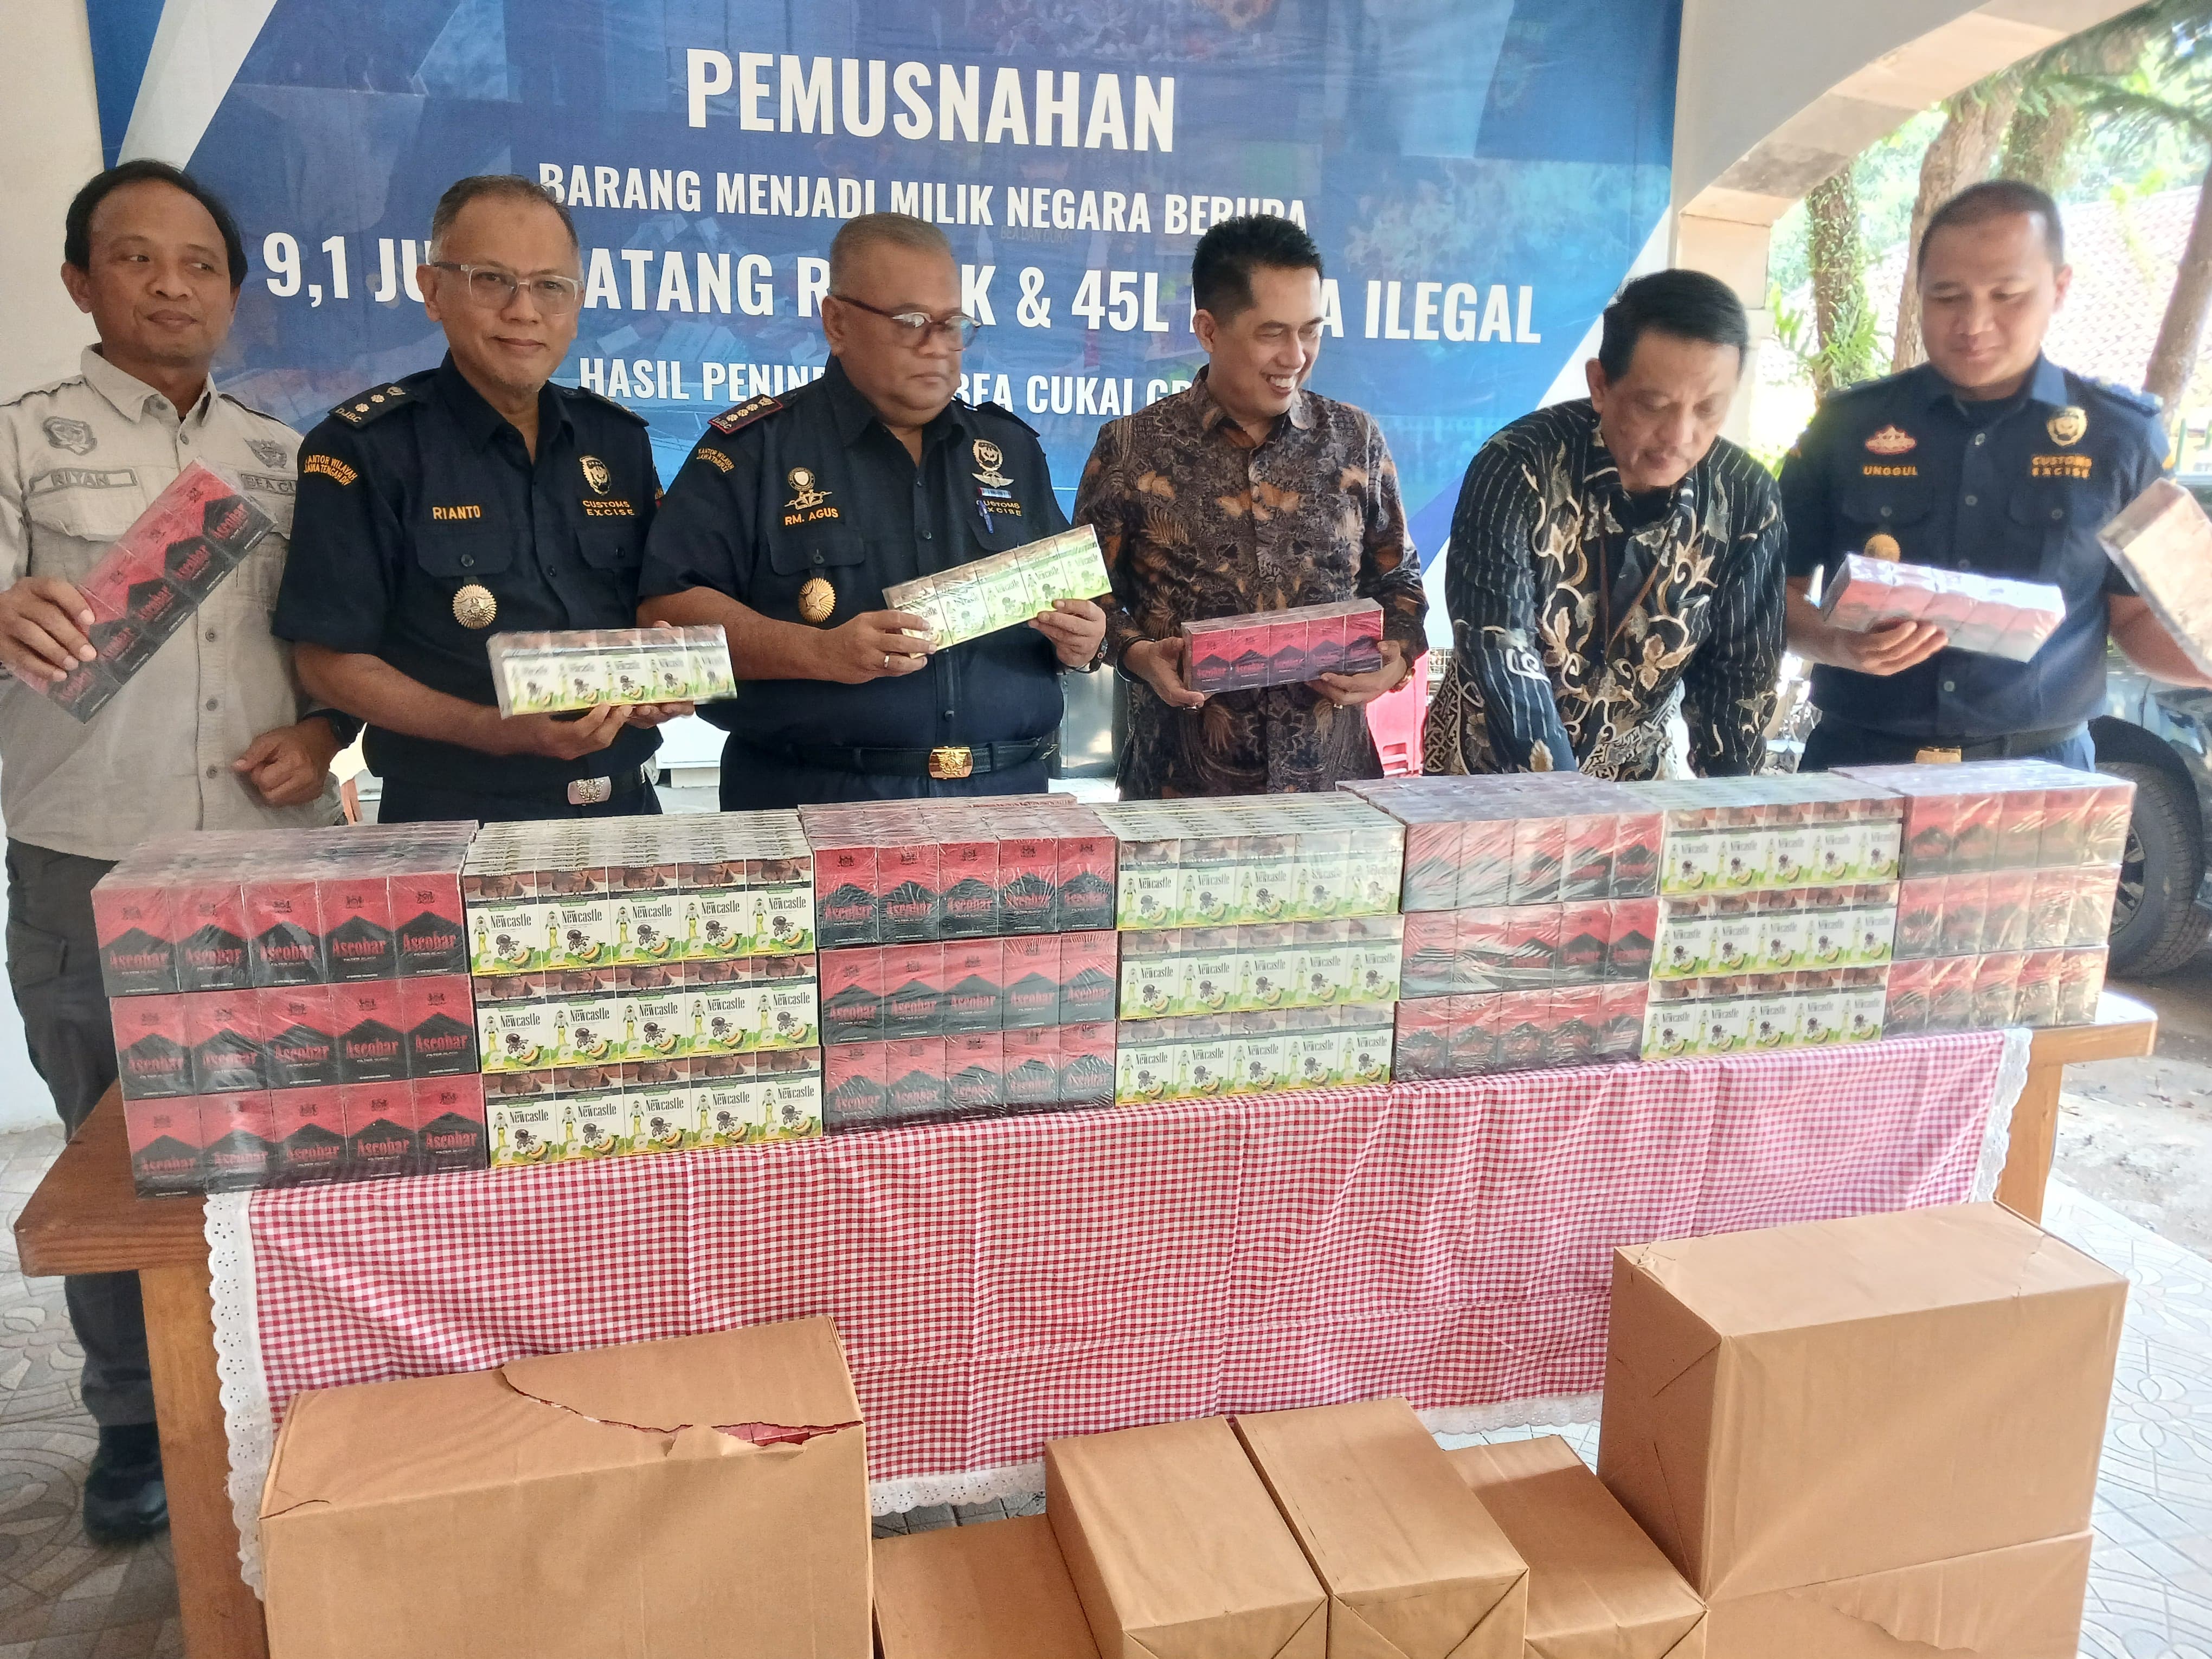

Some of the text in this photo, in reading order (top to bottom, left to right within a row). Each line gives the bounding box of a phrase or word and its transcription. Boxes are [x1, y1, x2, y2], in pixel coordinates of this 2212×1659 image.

[686, 48, 1175, 153] PEMUSNAHAN
[539, 163, 702, 213] BARANG
[716, 172, 875, 219] MENJADI
[890, 181, 994, 226] MILIK
[1007, 187, 1151, 234] NEGARA
[263, 232, 349, 308] 9,1
[583, 247, 774, 317] ATANG
[1016, 266, 1051, 328] &
[1071, 270, 1169, 332] 45L
[1365, 280, 1542, 344] ILEGAL
[580, 357, 690, 400] HASIL
[1026, 375, 1133, 416] CUKAI
[335, 408, 362, 422] DJBC
[304, 462, 320, 473] JAWA
[320, 464, 343, 480] TENGAH
[331, 458, 358, 481] WILAYAH
[51, 471, 110, 487] RIYAN
[432, 505, 481, 520] RIANTO
[785, 507, 839, 526] RM. AGUS
[987, 507, 1022, 517] XCISE
[1138, 874, 1172, 889] Newcastle
[1197, 872, 1230, 886] Newcastle
[701, 900, 740, 915] Newcastle
[769, 896, 806, 910] Newcastle
[562, 909, 602, 923] Newcastle
[633, 904, 672, 919] Newcastle
[491, 913, 531, 929] Newcastle
[1310, 955, 1341, 968] Newcastle
[1365, 951, 1395, 964] Newcastle
[1140, 965, 1173, 979] Newcastle
[1197, 962, 1230, 975] Newcastle
[1254, 959, 1285, 972] Newcastle
[707, 997, 745, 1012] Newcastle
[773, 992, 810, 1006] Newcastle
[570, 1007, 610, 1023] Newcastle
[639, 1002, 678, 1017] Newcastle
[500, 1013, 541, 1028] Newcastle
[1247, 1043, 1278, 1057] Newcastle
[1303, 1039, 1334, 1052] Newcastle
[1357, 1036, 1387, 1049] Newcastle
[1136, 1050, 1168, 1065] Newcastle
[1192, 1047, 1224, 1060] Newcastle
[713, 1091, 750, 1106] Newcastle
[778, 1085, 814, 1099] Newcastle
[578, 1103, 616, 1118] Newcastle
[646, 1097, 684, 1112] Newcastle
[510, 1109, 549, 1124] Newcastle
